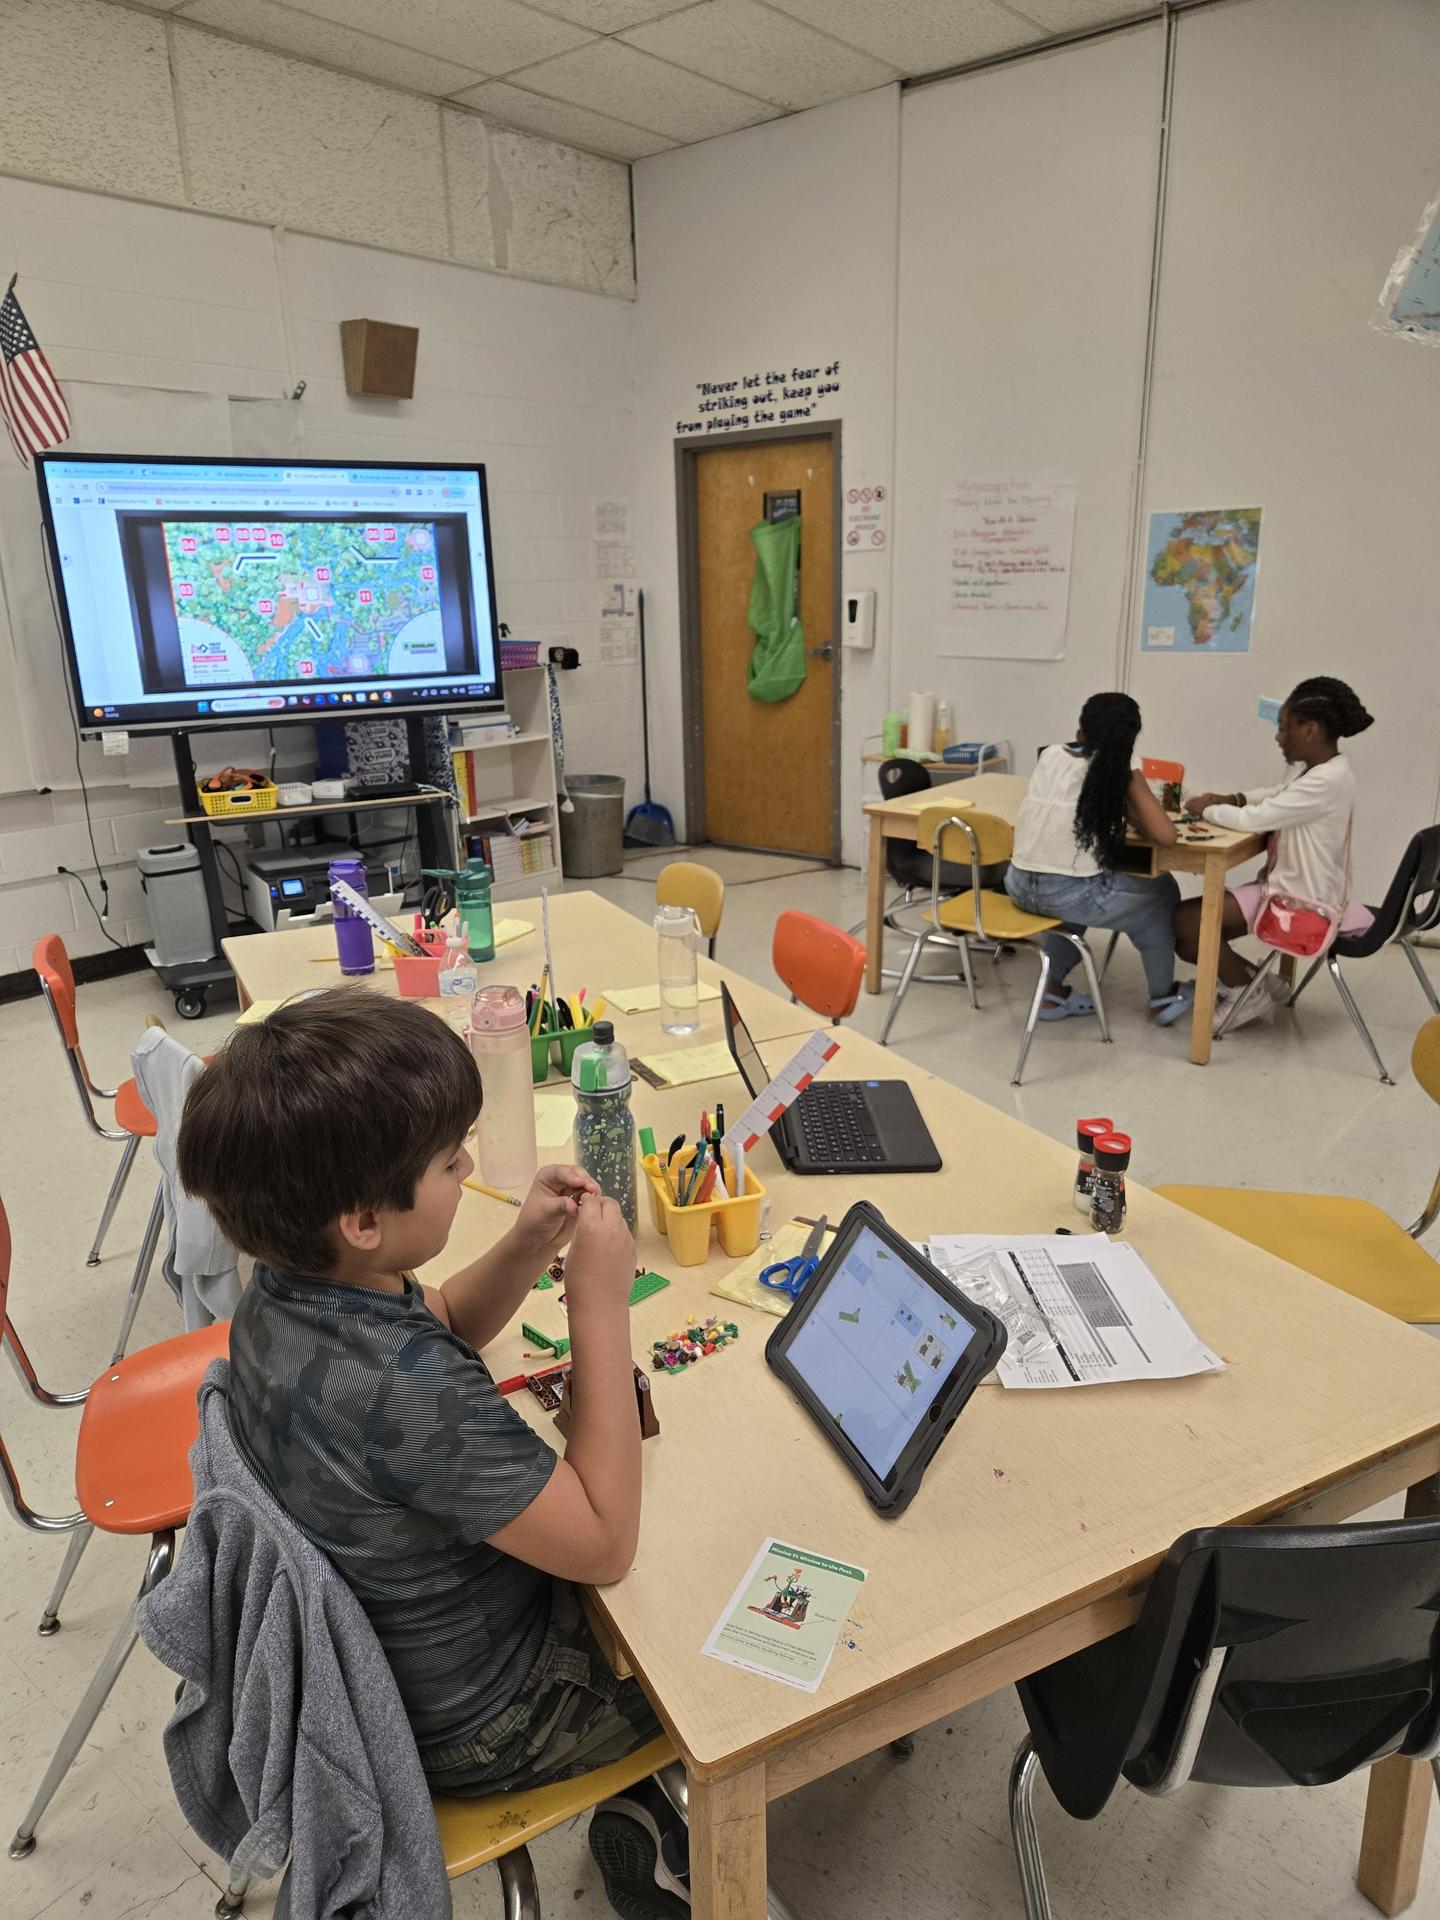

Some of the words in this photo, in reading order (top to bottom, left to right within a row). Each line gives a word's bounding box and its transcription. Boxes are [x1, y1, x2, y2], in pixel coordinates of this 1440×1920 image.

[696, 381, 738, 396] "Never
[743, 376, 760, 390] let
[765, 372, 786, 384] the
[791, 367, 820, 381] fear
[825, 361, 840, 376] of
[698, 395, 748, 413] striking
[783, 386, 812, 400] keep
[817, 382, 840, 398] you
[676, 421, 702, 434] from
[706, 414, 749, 433] playing
[753, 410, 775, 424] the
[780, 402, 817, 424] game"
[771, 1546, 792, 1557] Mission
[799, 1555, 821, 1566] Window
